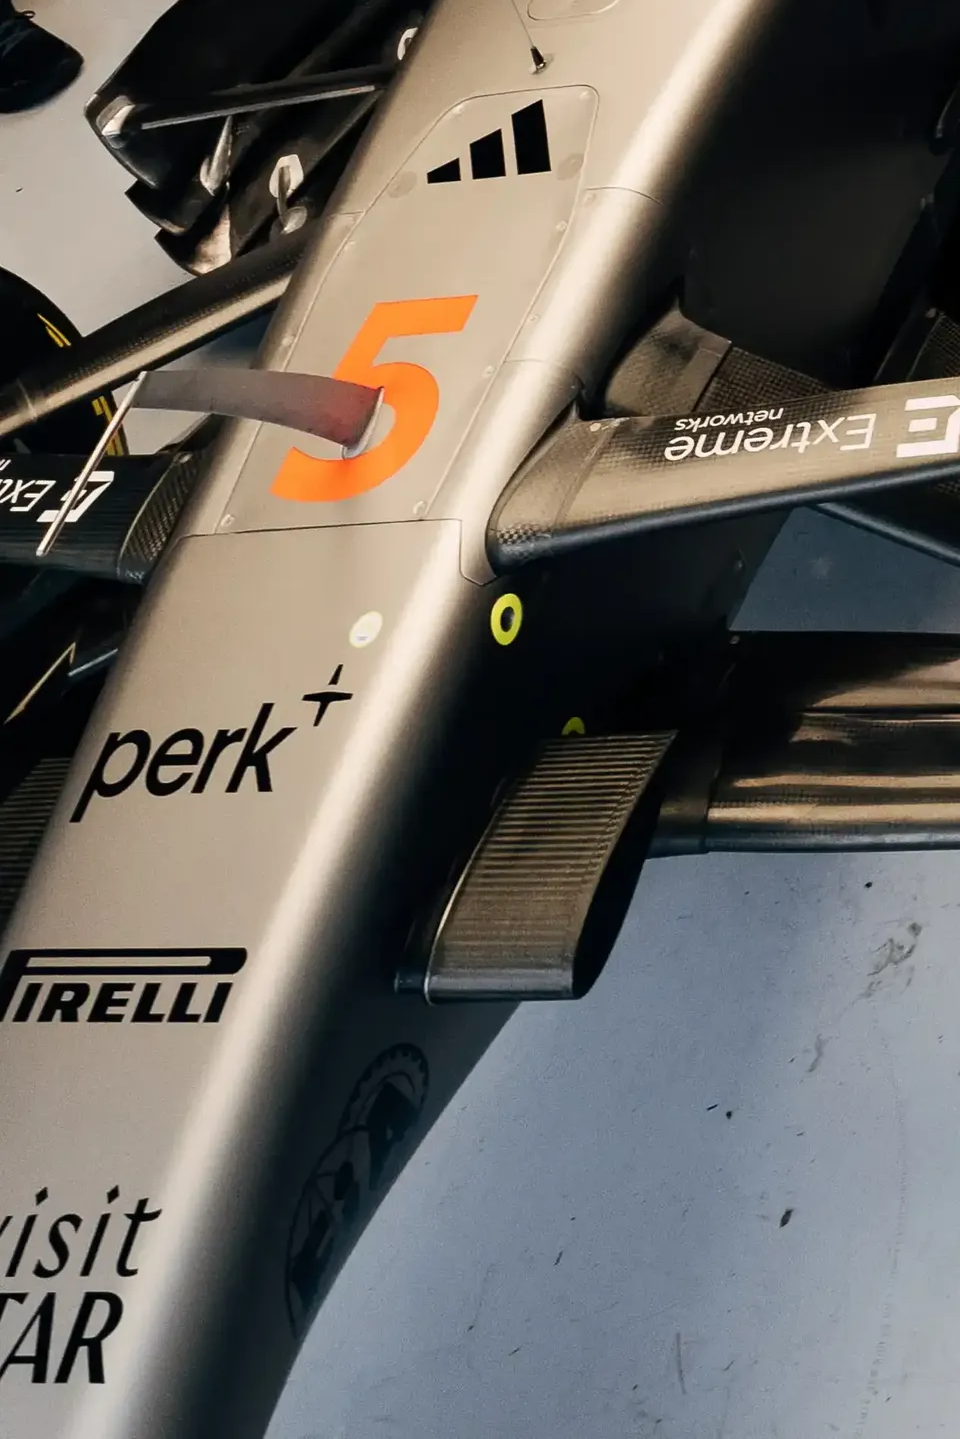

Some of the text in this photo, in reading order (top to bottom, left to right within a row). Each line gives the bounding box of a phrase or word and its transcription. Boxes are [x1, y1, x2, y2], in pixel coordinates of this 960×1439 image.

[270, 294, 479, 502] 5
[674, 407, 784, 433] networks
[663, 413, 877, 462] Extreme
[0, 947, 248, 1023] PIRELLI
